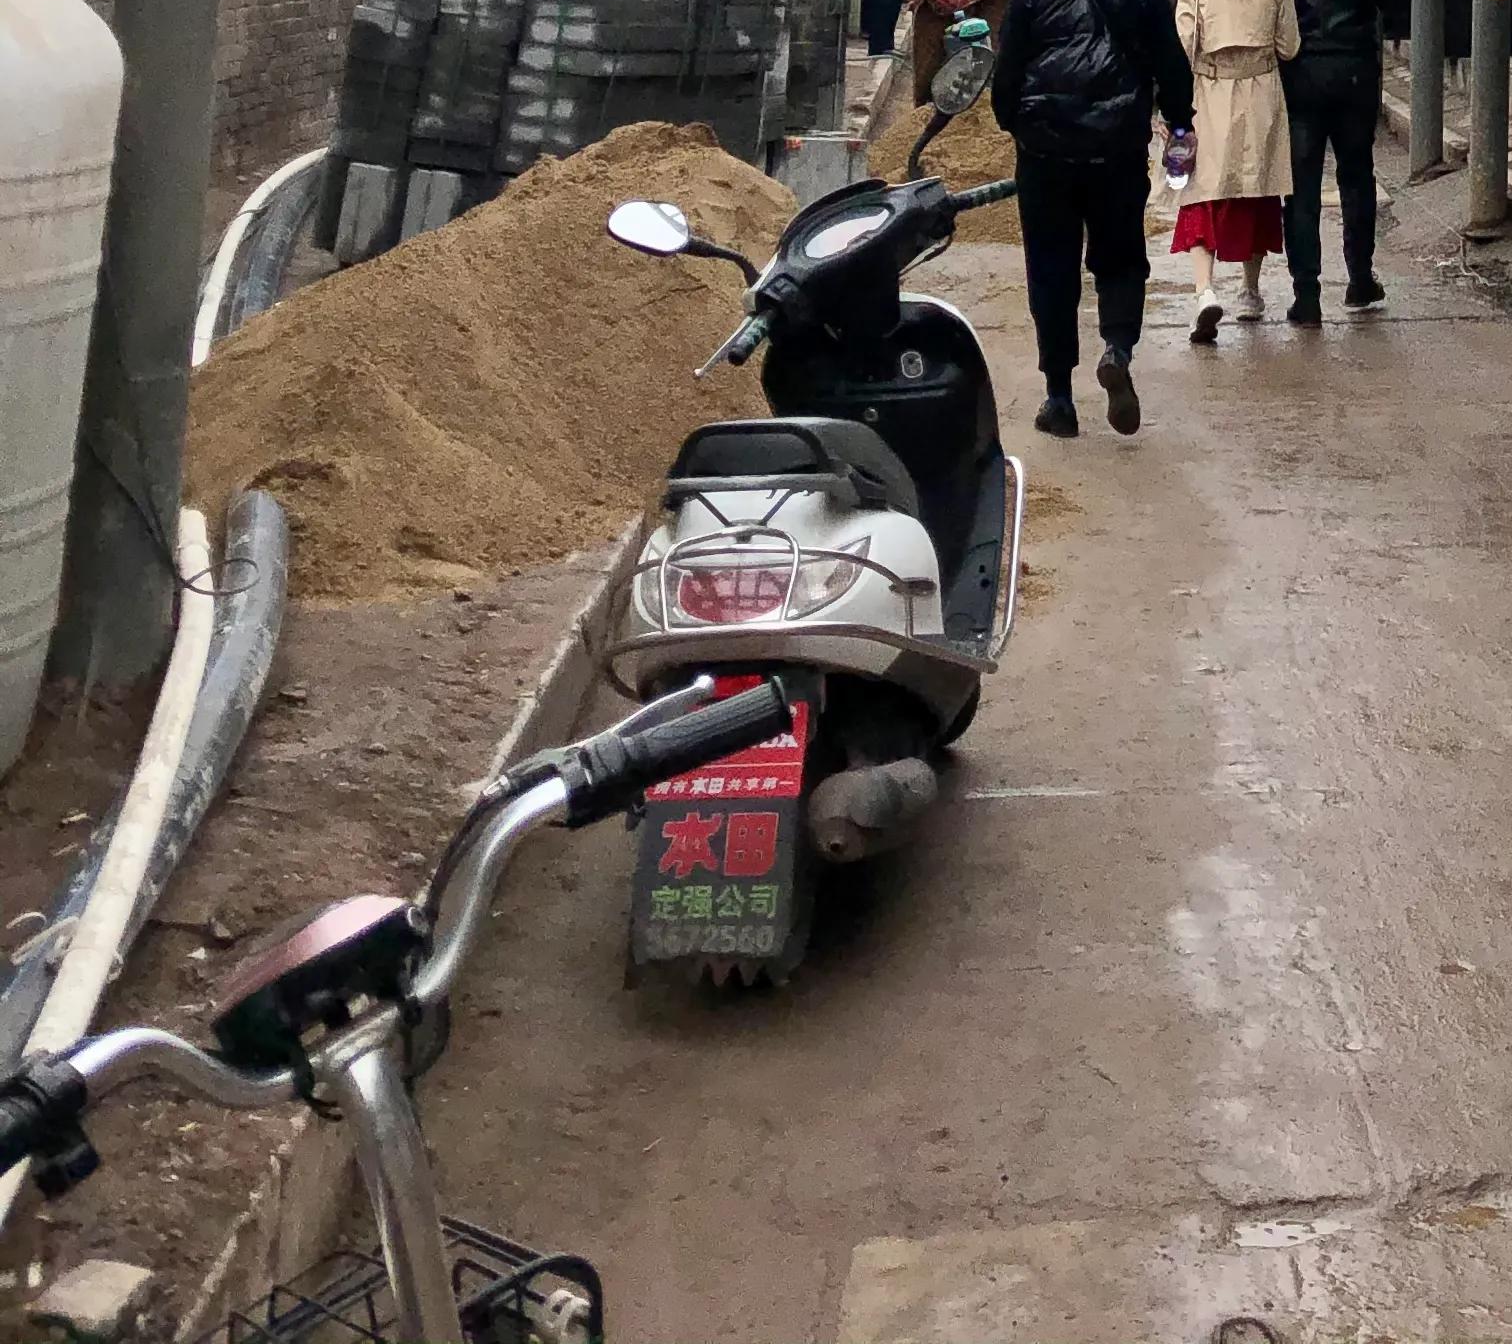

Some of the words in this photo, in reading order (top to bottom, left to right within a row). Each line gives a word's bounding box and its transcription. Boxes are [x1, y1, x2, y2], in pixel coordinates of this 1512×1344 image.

[658, 812, 779, 879] 本田
[650, 884, 779, 920] 定强公司
